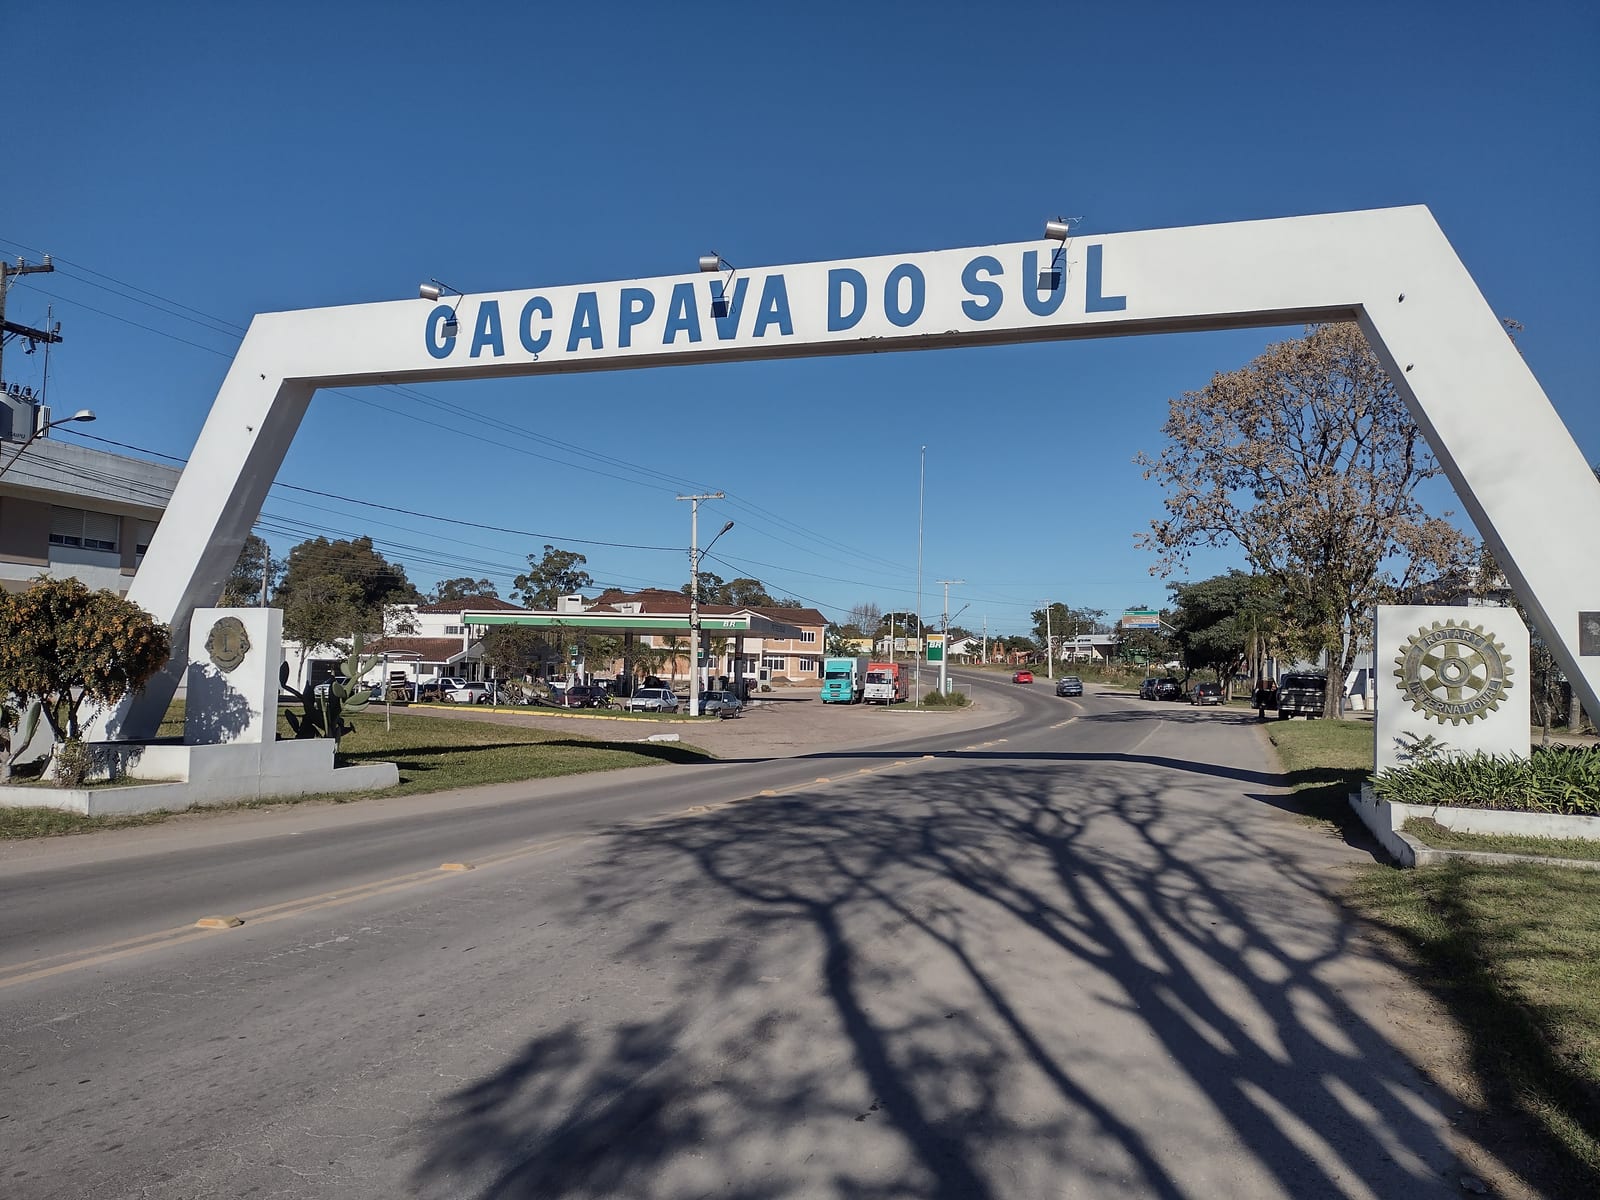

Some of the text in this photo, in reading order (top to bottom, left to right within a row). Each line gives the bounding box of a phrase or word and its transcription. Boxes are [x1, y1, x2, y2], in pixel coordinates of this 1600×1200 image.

[425, 244, 1126, 361] CAÇAPAVA DO SUL
[929, 641, 942, 649] BR
[1424, 629, 1482, 647] ROTARY
[1409, 681, 1501, 715] INTERNATIONAL
